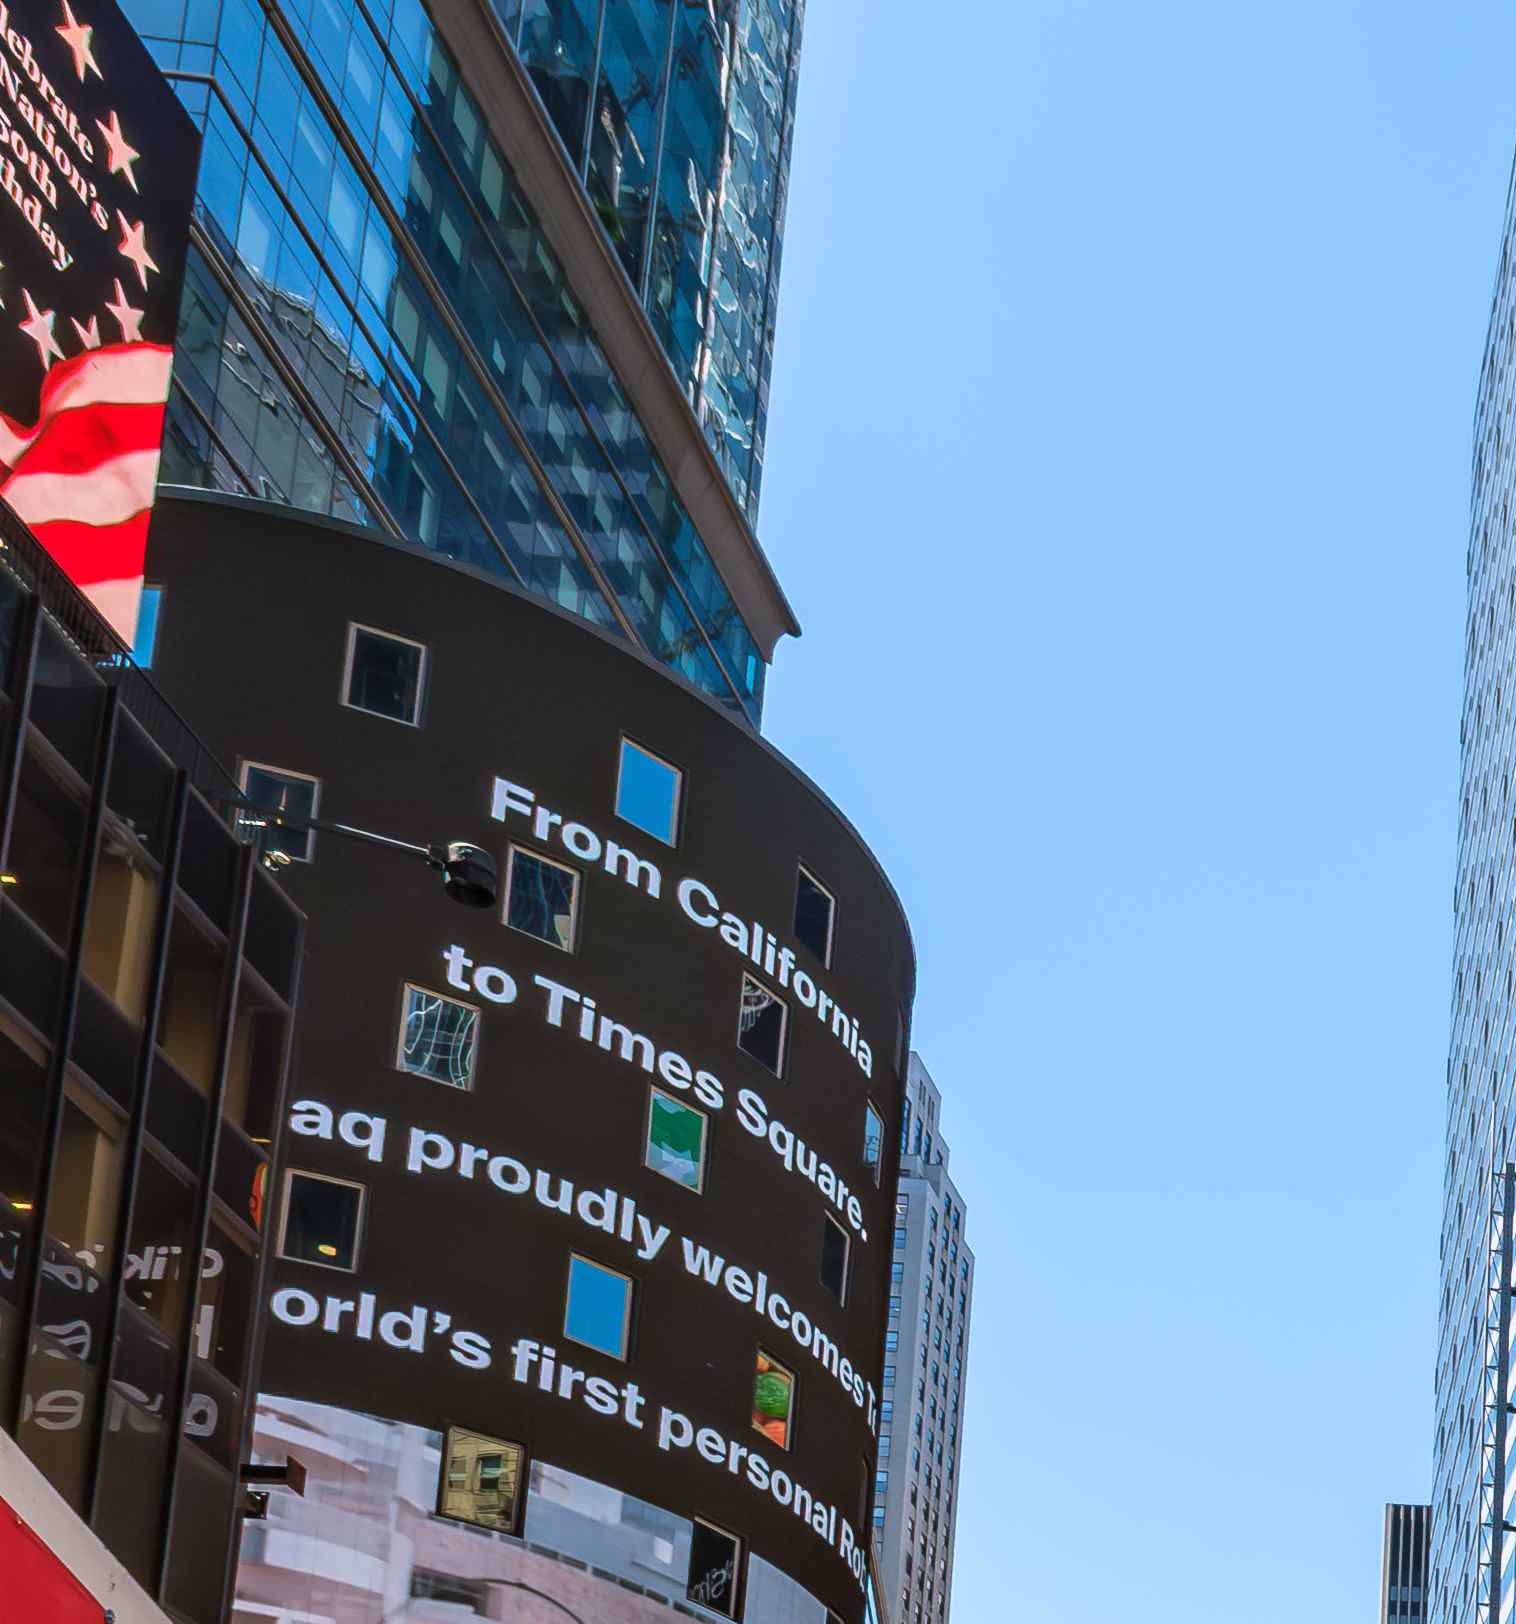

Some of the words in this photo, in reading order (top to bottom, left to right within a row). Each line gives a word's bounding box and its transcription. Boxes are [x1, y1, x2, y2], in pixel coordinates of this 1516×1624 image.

[490, 776, 662, 899] From
[677, 877, 875, 1080] California
[442, 942, 518, 1003] to
[534, 973, 725, 1110] Times
[736, 1087, 870, 1242] Square.
[407, 1127, 673, 1263] proudly
[681, 1240, 865, 1409] welcomes
[512, 1337, 645, 1432] first
[658, 1406, 837, 1547] personal
